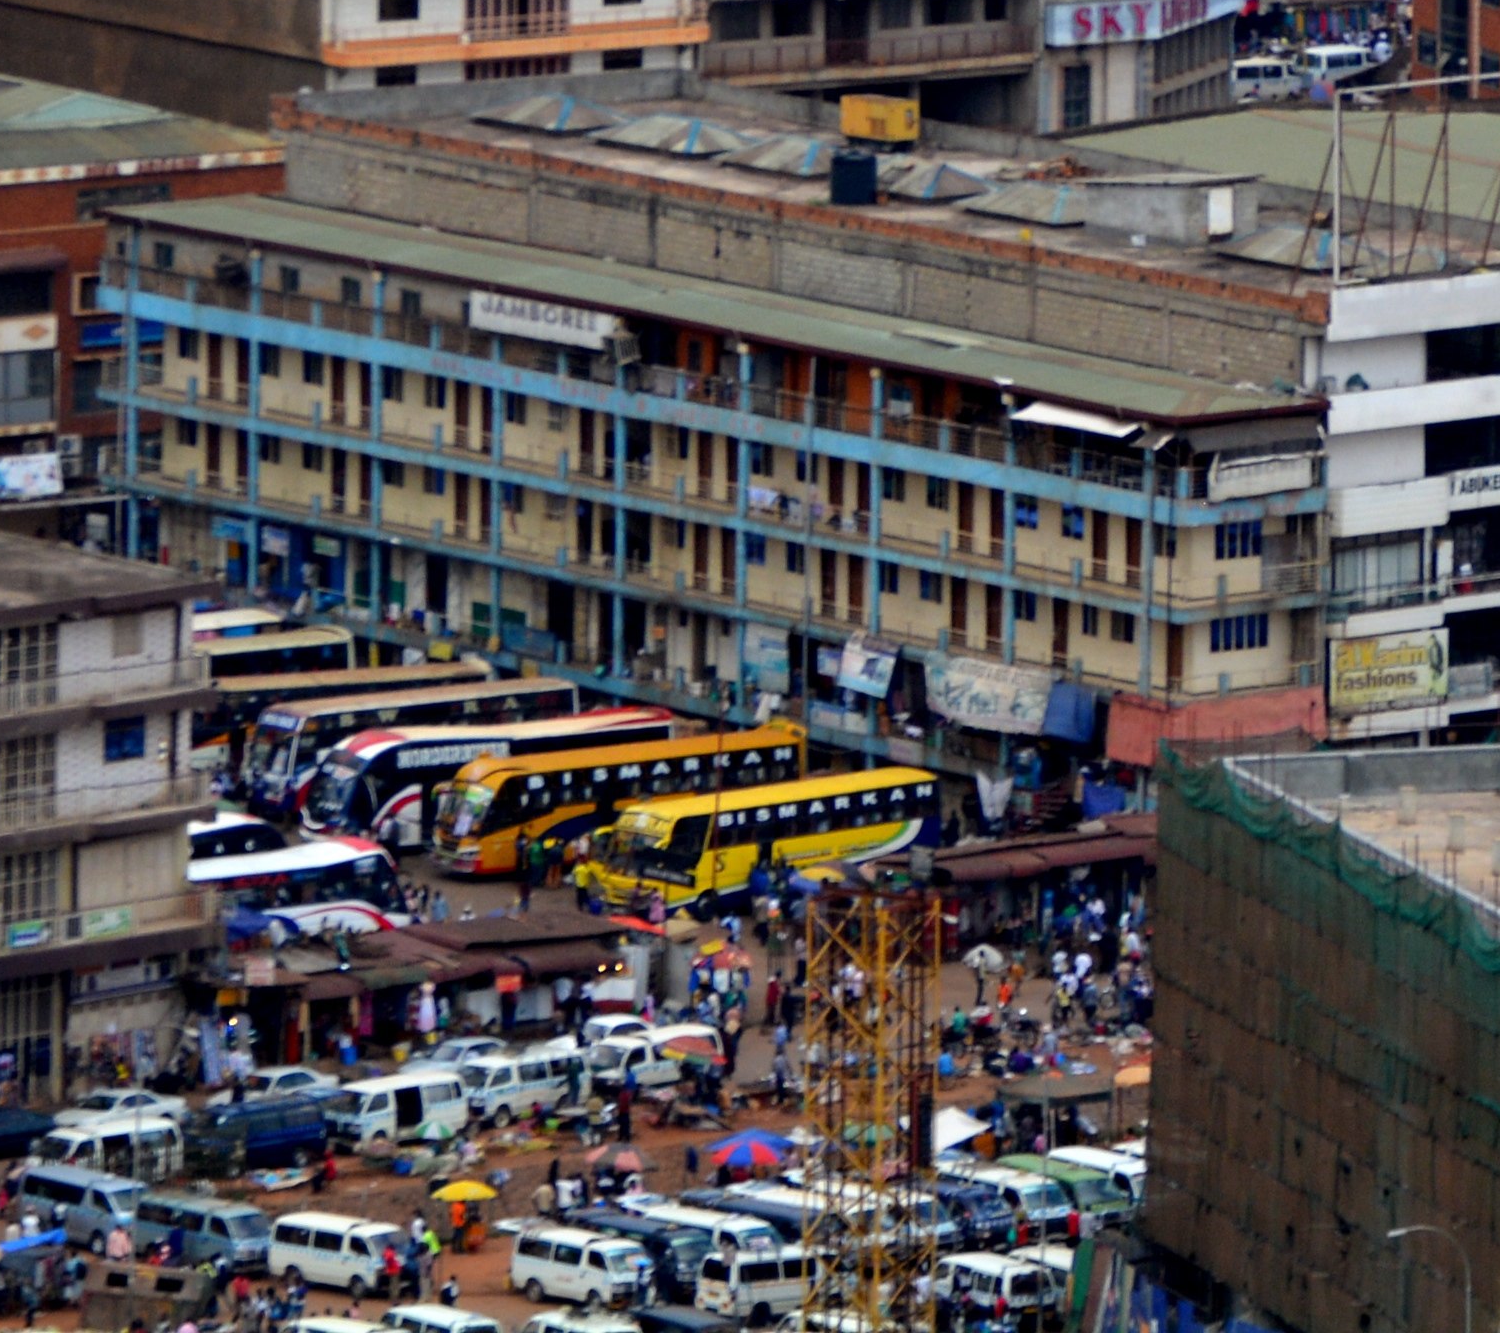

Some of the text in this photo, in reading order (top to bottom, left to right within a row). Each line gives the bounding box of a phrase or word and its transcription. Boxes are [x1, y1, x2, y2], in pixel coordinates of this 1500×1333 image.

[1074, 3, 1152, 38] SKY
[479, 296, 599, 333] JAMBOREE
[1336, 667, 1418, 694] fashions
[527, 745, 793, 791] BISMARKAN
[718, 783, 934, 828] BISMARKAN
